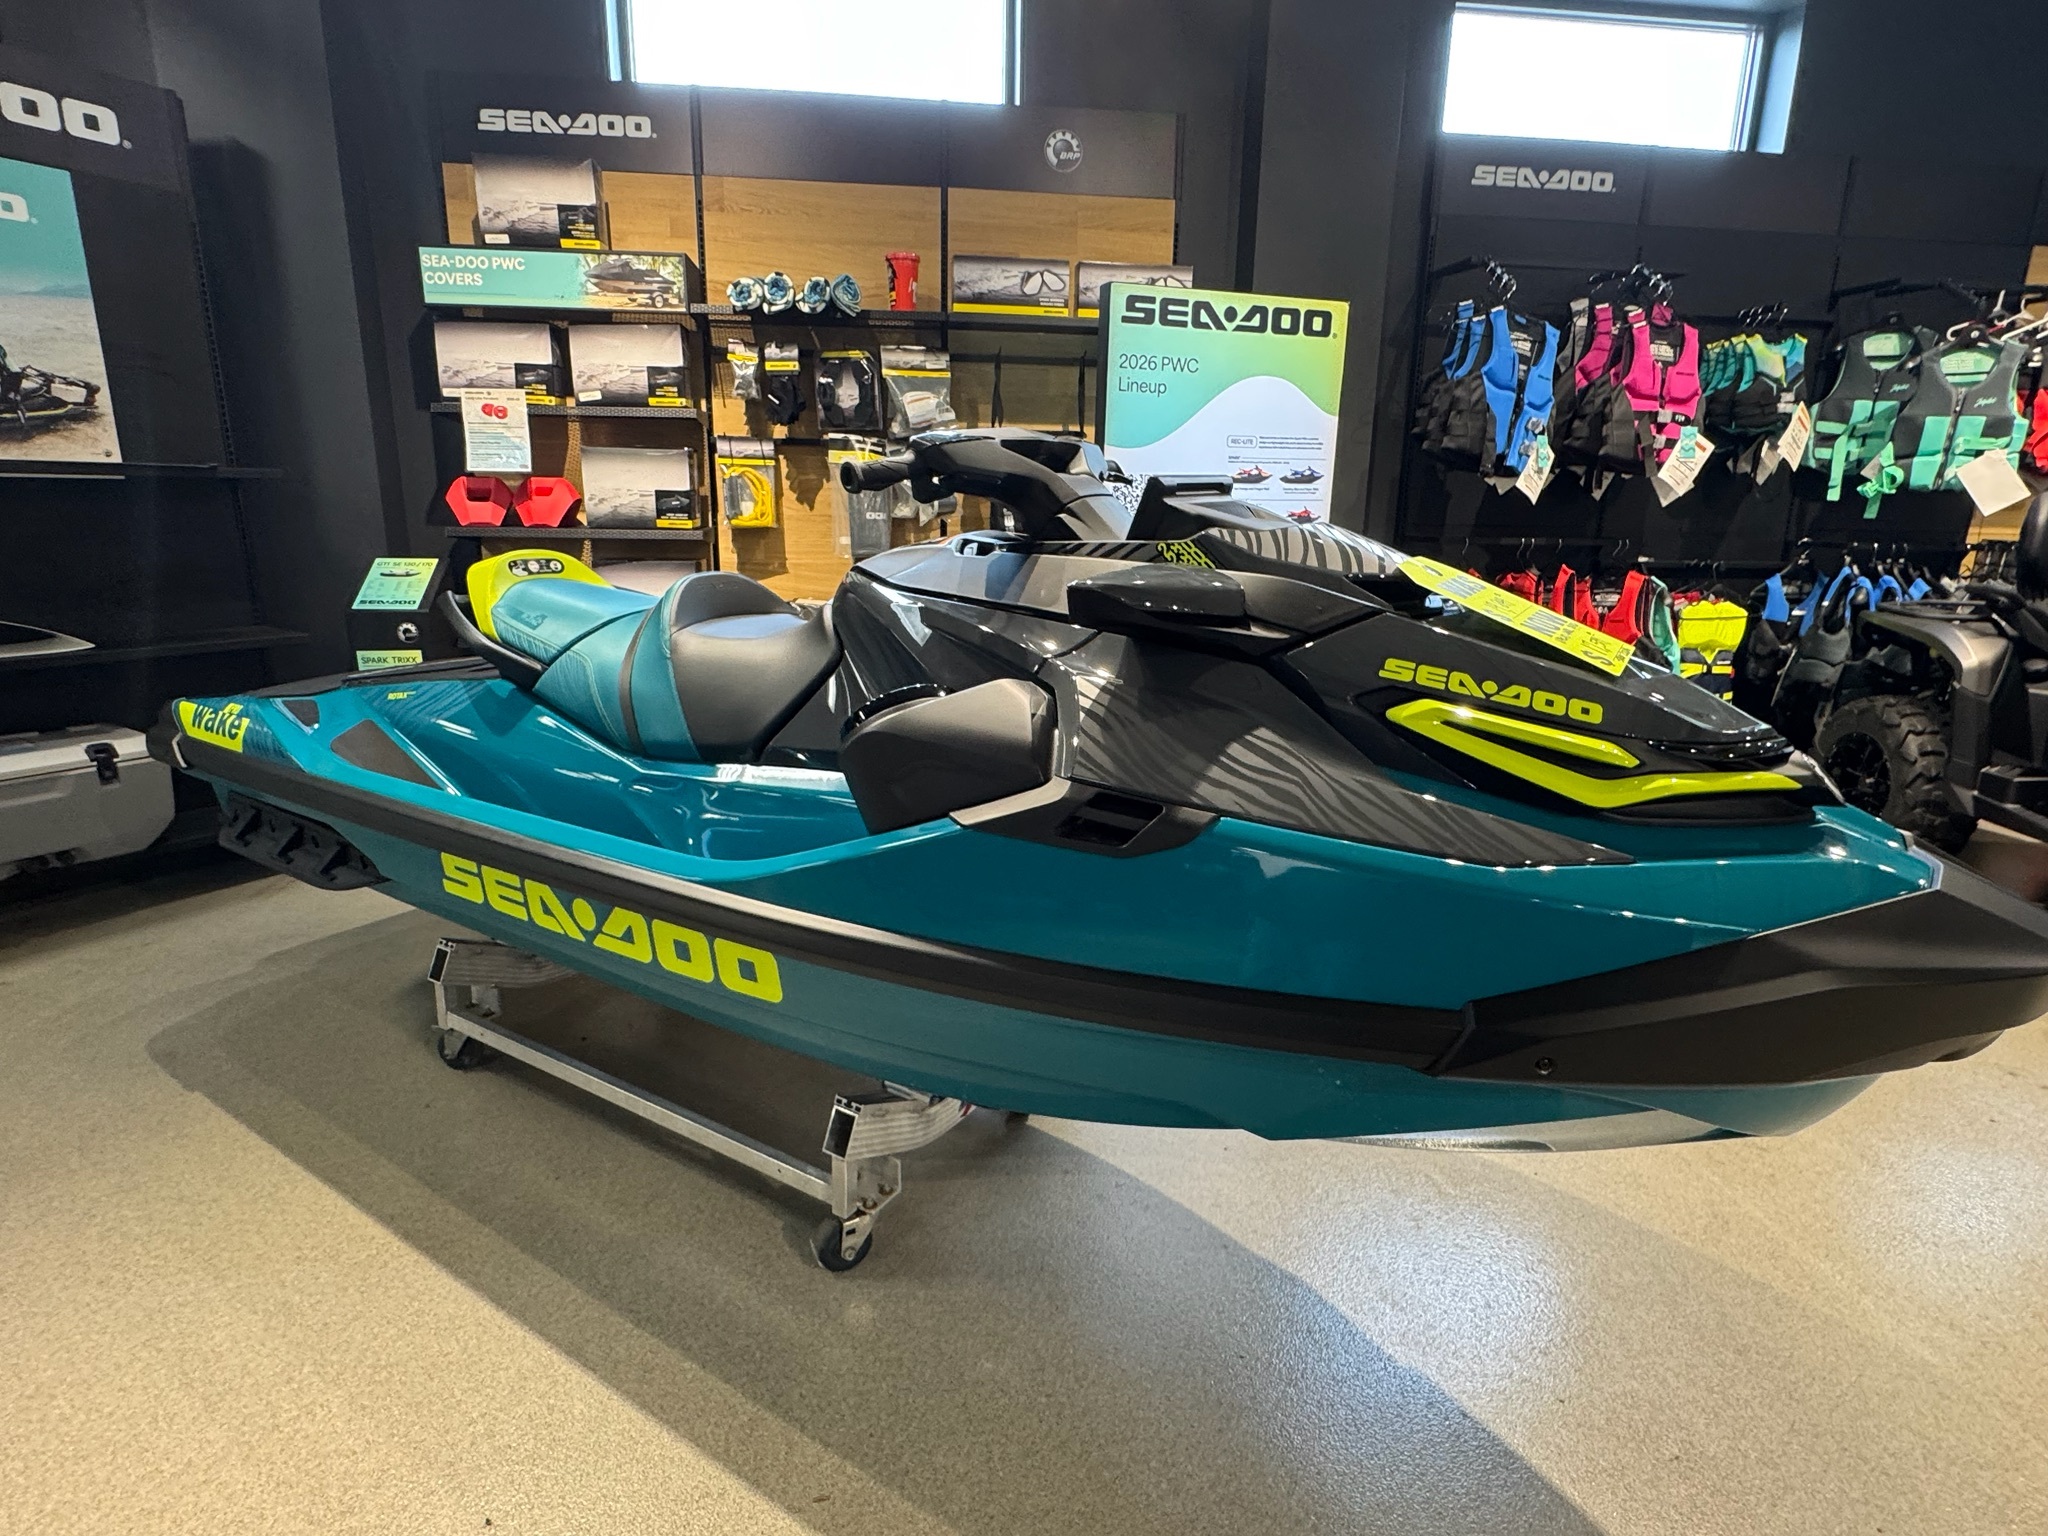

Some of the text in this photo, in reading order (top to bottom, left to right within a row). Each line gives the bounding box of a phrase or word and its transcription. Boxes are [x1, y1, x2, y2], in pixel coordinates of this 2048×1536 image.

[421, 254, 526, 270] SEA-DOO PWC
[424, 271, 483, 286] COVERS
[1119, 353, 1199, 373] 2026 PWC
[1118, 376, 1167, 397] Lineup
[1520, 609, 1568, 638] NOW
[360, 656, 419, 665] SPARK TRIXX
[191, 704, 242, 741] Wake
